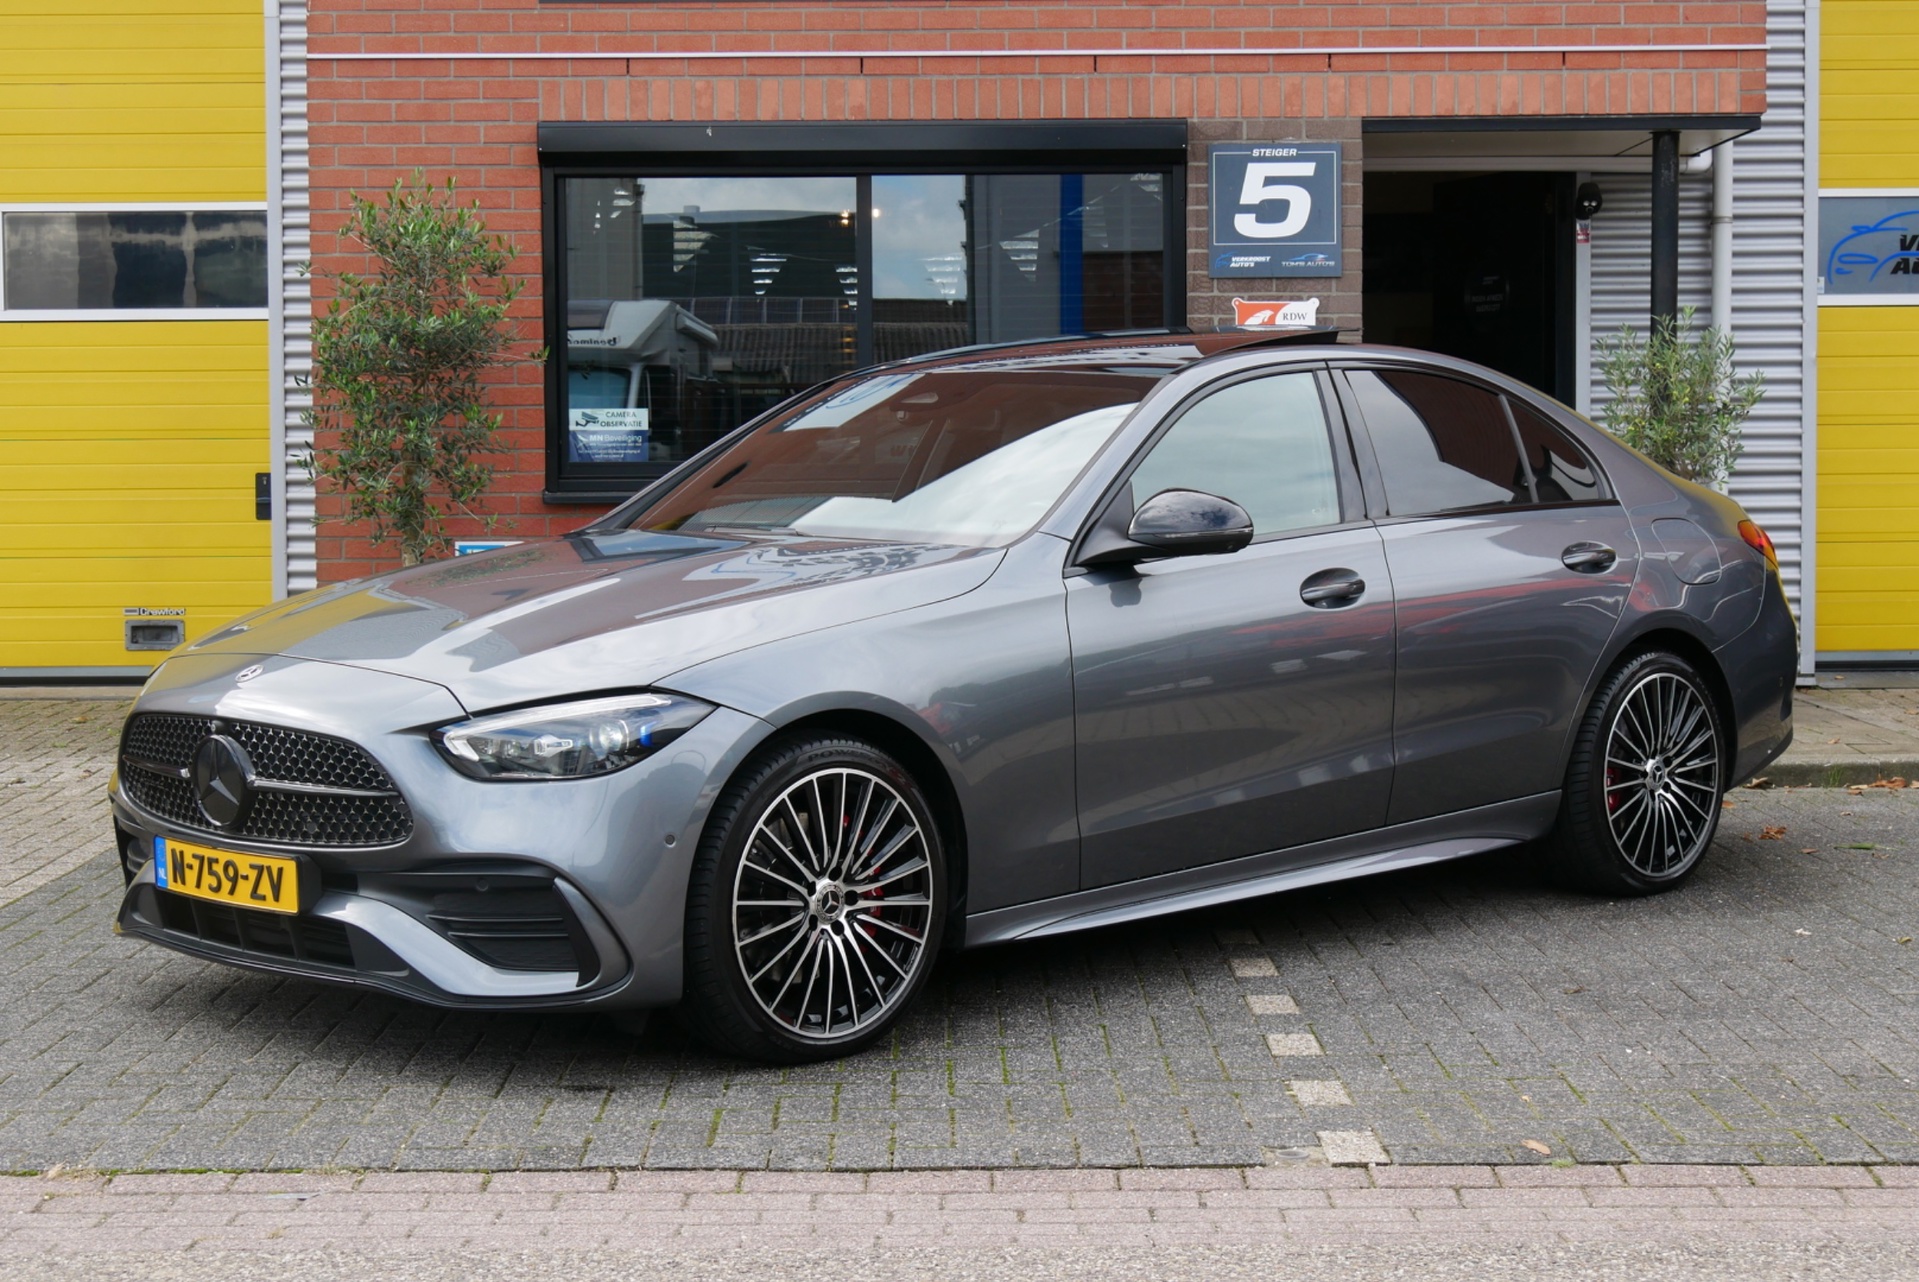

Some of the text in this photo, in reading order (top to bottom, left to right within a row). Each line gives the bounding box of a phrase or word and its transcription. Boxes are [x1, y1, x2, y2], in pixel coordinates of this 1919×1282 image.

[1252, 148, 1298, 157] STEIGER
[1233, 162, 1317, 239] 5
[1900, 234, 1919, 252] V
[1282, 312, 1308, 321] RDW
[170, 847, 284, 903] N-759-ZV
